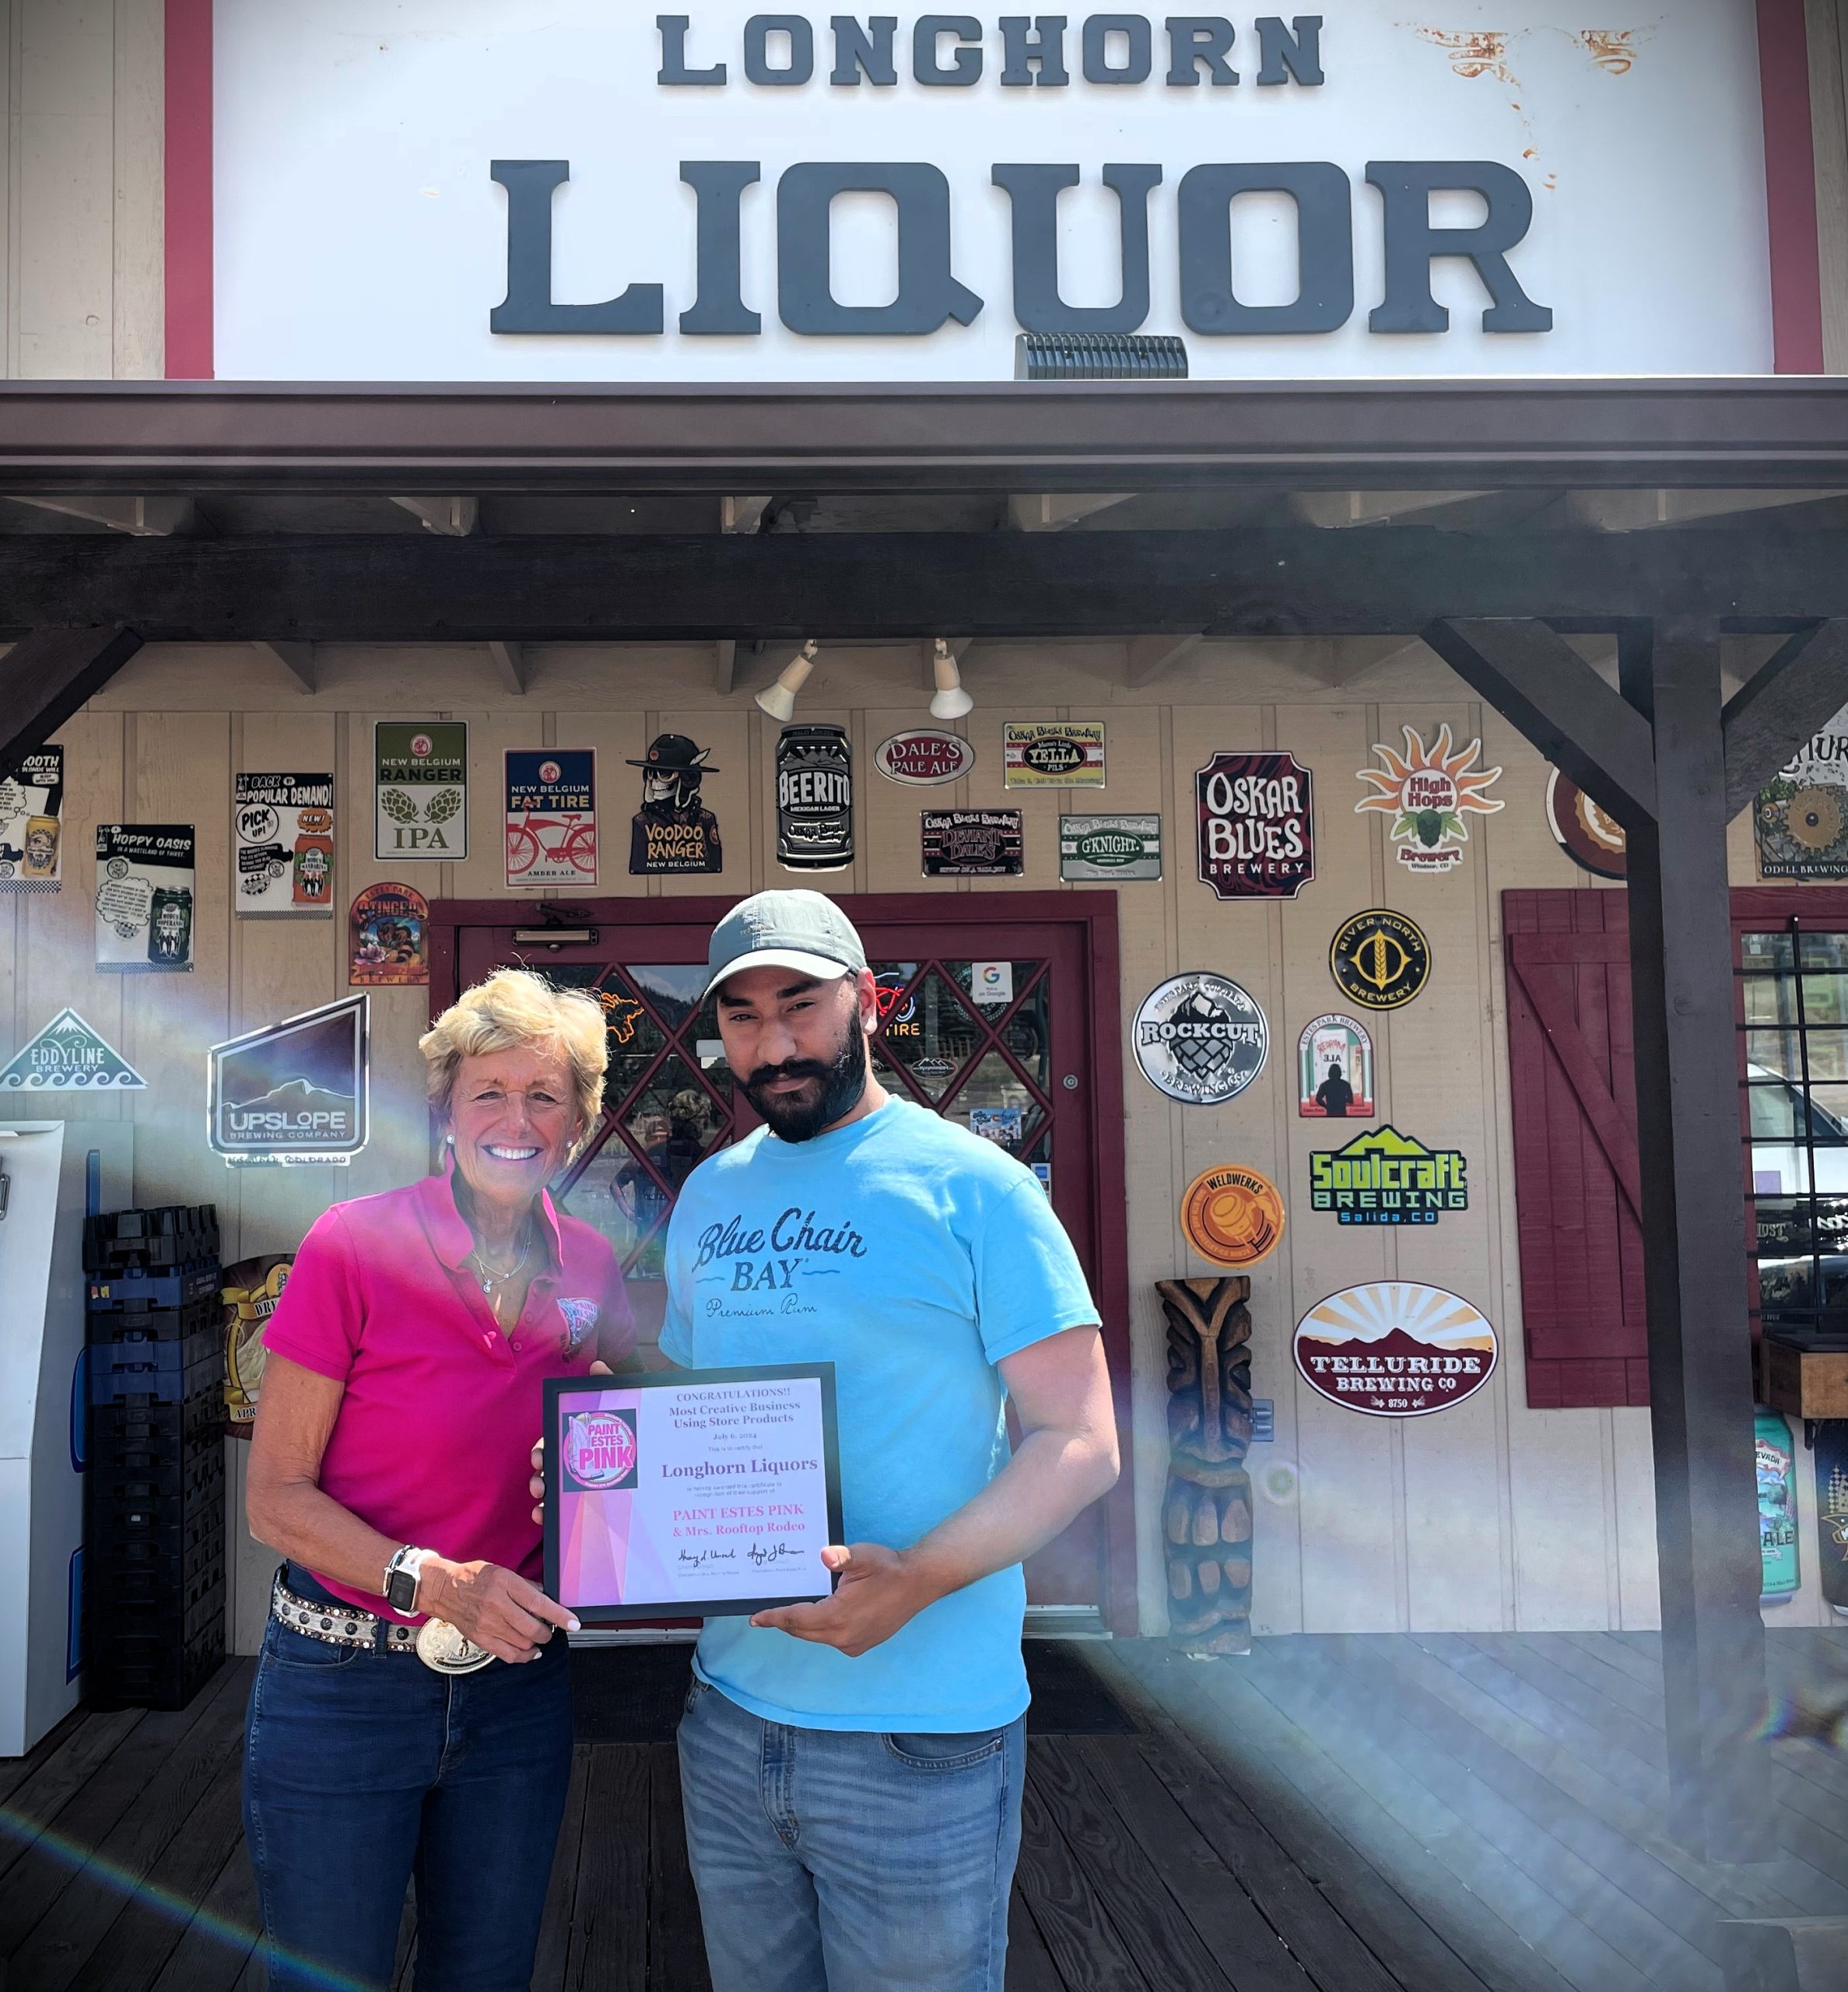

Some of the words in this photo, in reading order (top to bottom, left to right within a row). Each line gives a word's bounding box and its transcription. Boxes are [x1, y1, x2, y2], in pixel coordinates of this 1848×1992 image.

[656, 14, 1324, 86] LONGHORN
[490, 160, 1553, 336] LIQUOR
[889, 742, 961, 759] DALE'S
[1029, 748, 1081, 763] YELLA
[23, 756, 59, 767] OOTH
[890, 761, 926, 774] PALE
[930, 761, 959, 774] ALE
[251, 777, 281, 788] BACK
[380, 769, 461, 782] RANGER
[779, 770, 850, 808] BEERITO
[1410, 777, 1451, 794] High
[247, 787, 289, 805] POPULAR
[290, 784, 333, 807] DEMAND!
[511, 795, 545, 808] FAT
[549, 794, 590, 808] TIRE
[1206, 772, 1303, 820] OSKAR
[1408, 792, 1453, 809] Hops
[241, 808, 270, 831] PICK
[303, 815, 325, 823] NEW!
[252, 825, 266, 838] UP!
[393, 828, 450, 849] IPA
[645, 825, 703, 841] VOODOO
[942, 827, 1003, 848] DEVIANT
[1208, 817, 1303, 861] BLUES
[112, 834, 154, 847] HOPPY
[156, 837, 191, 850] OASIS
[647, 842, 704, 860] RANGER
[1400, 847, 1461, 862] Brewery
[1210, 862, 1304, 875] BREWERY
[1764, 865, 1797, 874] ODELL
[393, 886, 413, 900] PARK
[1339, 917, 1376, 952] RIVER
[1382, 917, 1422, 952] NORTH
[359, 975, 422, 984] BREWERY
[1350, 980, 1411, 1002] BREWERY
[1141, 1021, 1260, 1046] ROCKCUT
[1301, 1024, 1317, 1045] ESTES
[1317, 1015, 1339, 1026] PARK
[1339, 1016, 1368, 1045] BREWERY
[30, 1044, 105, 1065] EDDYLINE
[36, 1064, 99, 1073] BREWERY
[230, 1111, 346, 1131] UPSLOPE
[229, 1131, 283, 1140] BREWING
[285, 1155, 346, 1164] COLORADO
[1313, 1154, 1465, 1190] Soulcraft
[1206, 1173, 1264, 1194] WELDWERKS
[1313, 1191, 1465, 1208] BREWING
[692, 1214, 765, 1273] Blue
[771, 1207, 868, 1257] Chair
[730, 1257, 803, 1292] BAY
[706, 1298, 774, 1317] Premium
[780, 1292, 817, 1314] Rum
[1310, 1356, 1481, 1374] TELLURIDE
[1336, 1377, 1434, 1392] BREWING
[676, 1387, 791, 1402] CONGRATULATIONS!!
[1388, 1398, 1408, 1408] 8750
[669, 1405, 696, 1417] Most
[700, 1403, 747, 1415] Creative
[750, 1401, 801, 1412] Business
[588, 1422, 622, 1436] PAINT
[674, 1419, 707, 1429] Using
[709, 1417, 740, 1427] Store
[743, 1413, 794, 1425] Products
[591, 1435, 623, 1447] ESTES
[713, 1433, 728, 1441] July
[579, 1445, 634, 1471] PINK
[661, 1461, 746, 1480] Longhorn
[750, 1458, 818, 1475] Liquors
[673, 1508, 717, 1521] PAINT
[721, 1506, 764, 1519] ESTES
[768, 1503, 804, 1516] PINK
[673, 1527, 682, 1538] &
[686, 1525, 712, 1537] Mrs.
[716, 1523, 764, 1536] Rooftop
[767, 1521, 805, 1532] Rodeo
[1762, 1531, 1794, 1547] ALE
